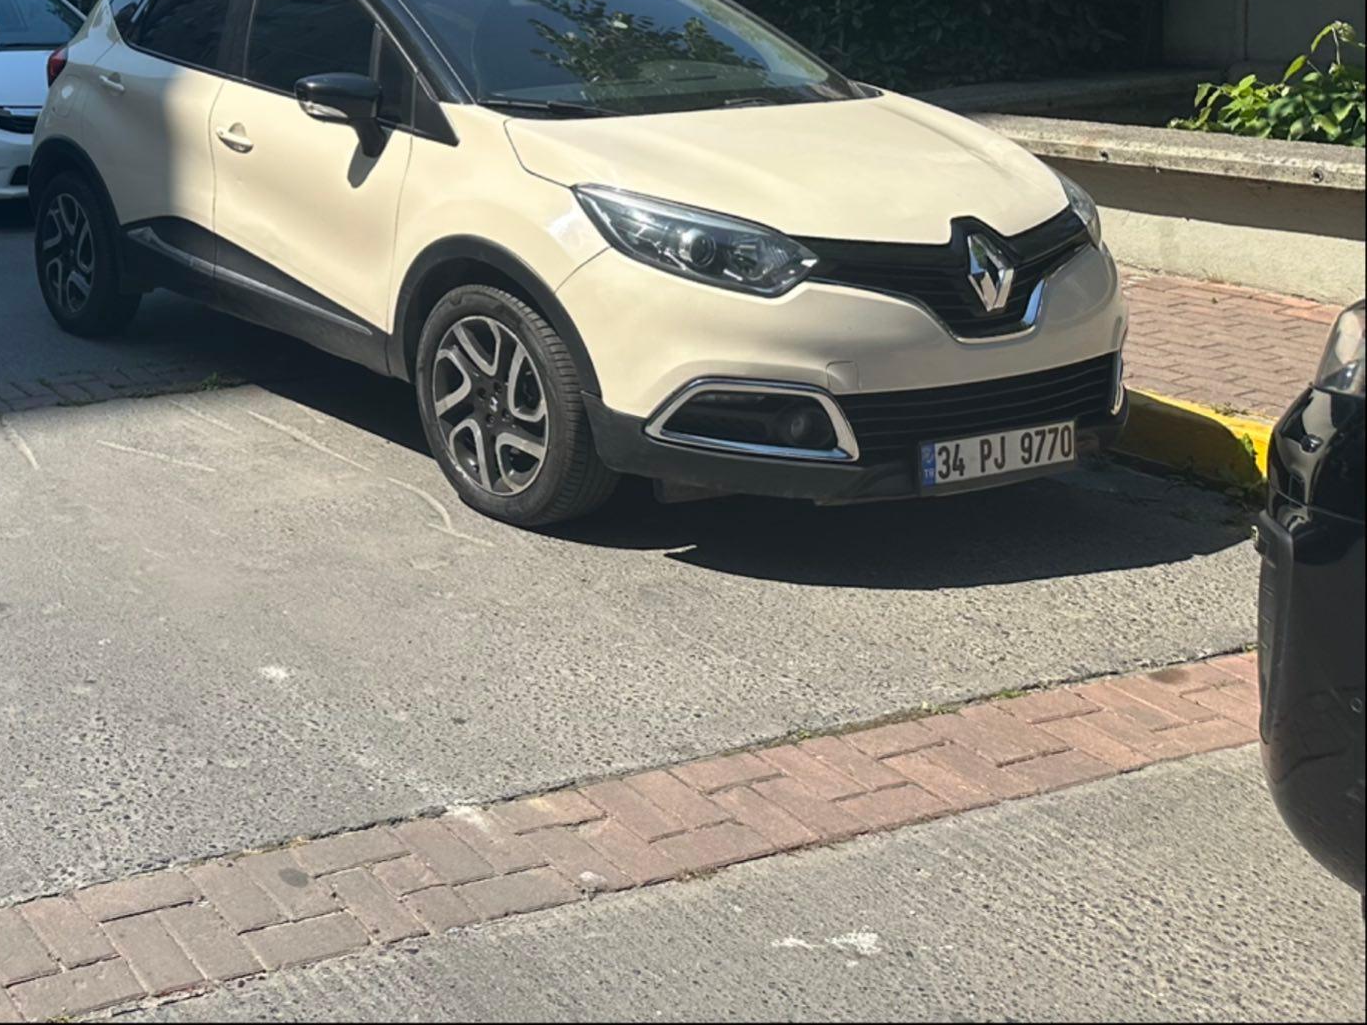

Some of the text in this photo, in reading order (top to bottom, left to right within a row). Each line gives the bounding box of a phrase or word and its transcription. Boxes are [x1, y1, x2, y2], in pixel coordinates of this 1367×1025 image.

[937, 424, 1072, 480] 34 PJ 9770
